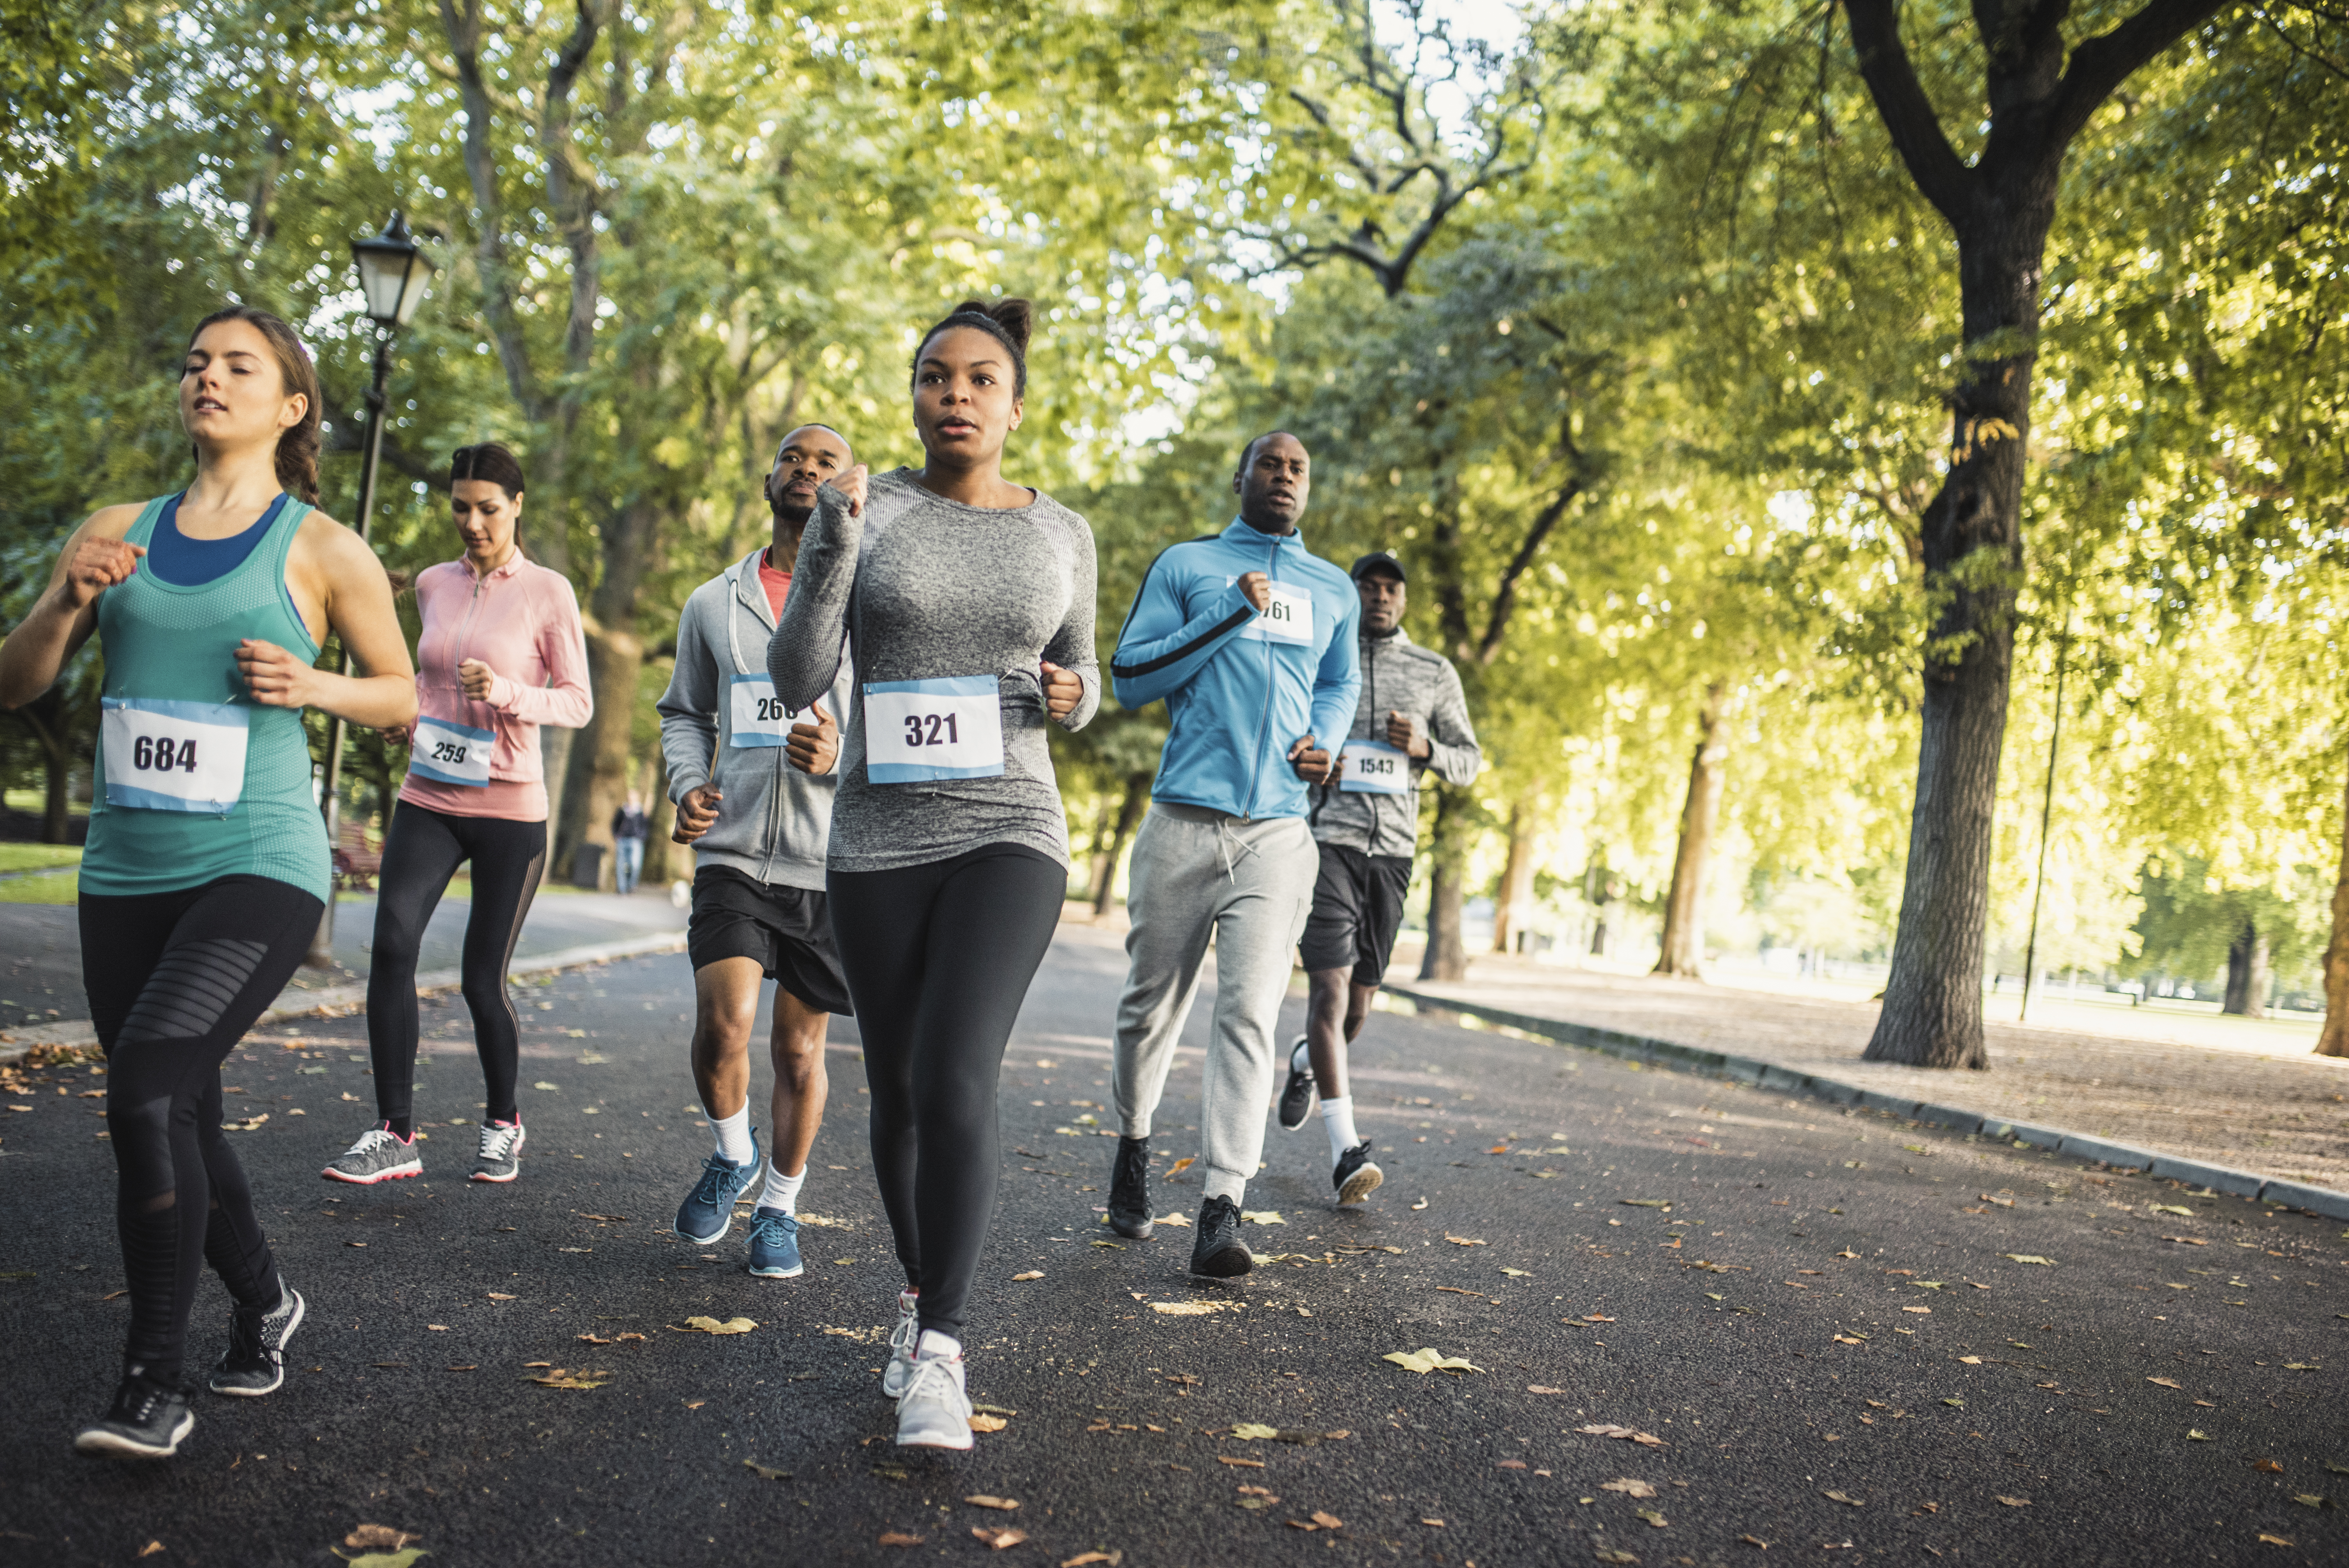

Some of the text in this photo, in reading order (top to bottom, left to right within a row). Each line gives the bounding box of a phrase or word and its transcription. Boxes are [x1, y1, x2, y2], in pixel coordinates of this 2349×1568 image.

[904, 713, 957, 747] 321
[134, 736, 197, 773] 684
[431, 741, 467, 764] 259
[1360, 758, 1394, 774] 1543
